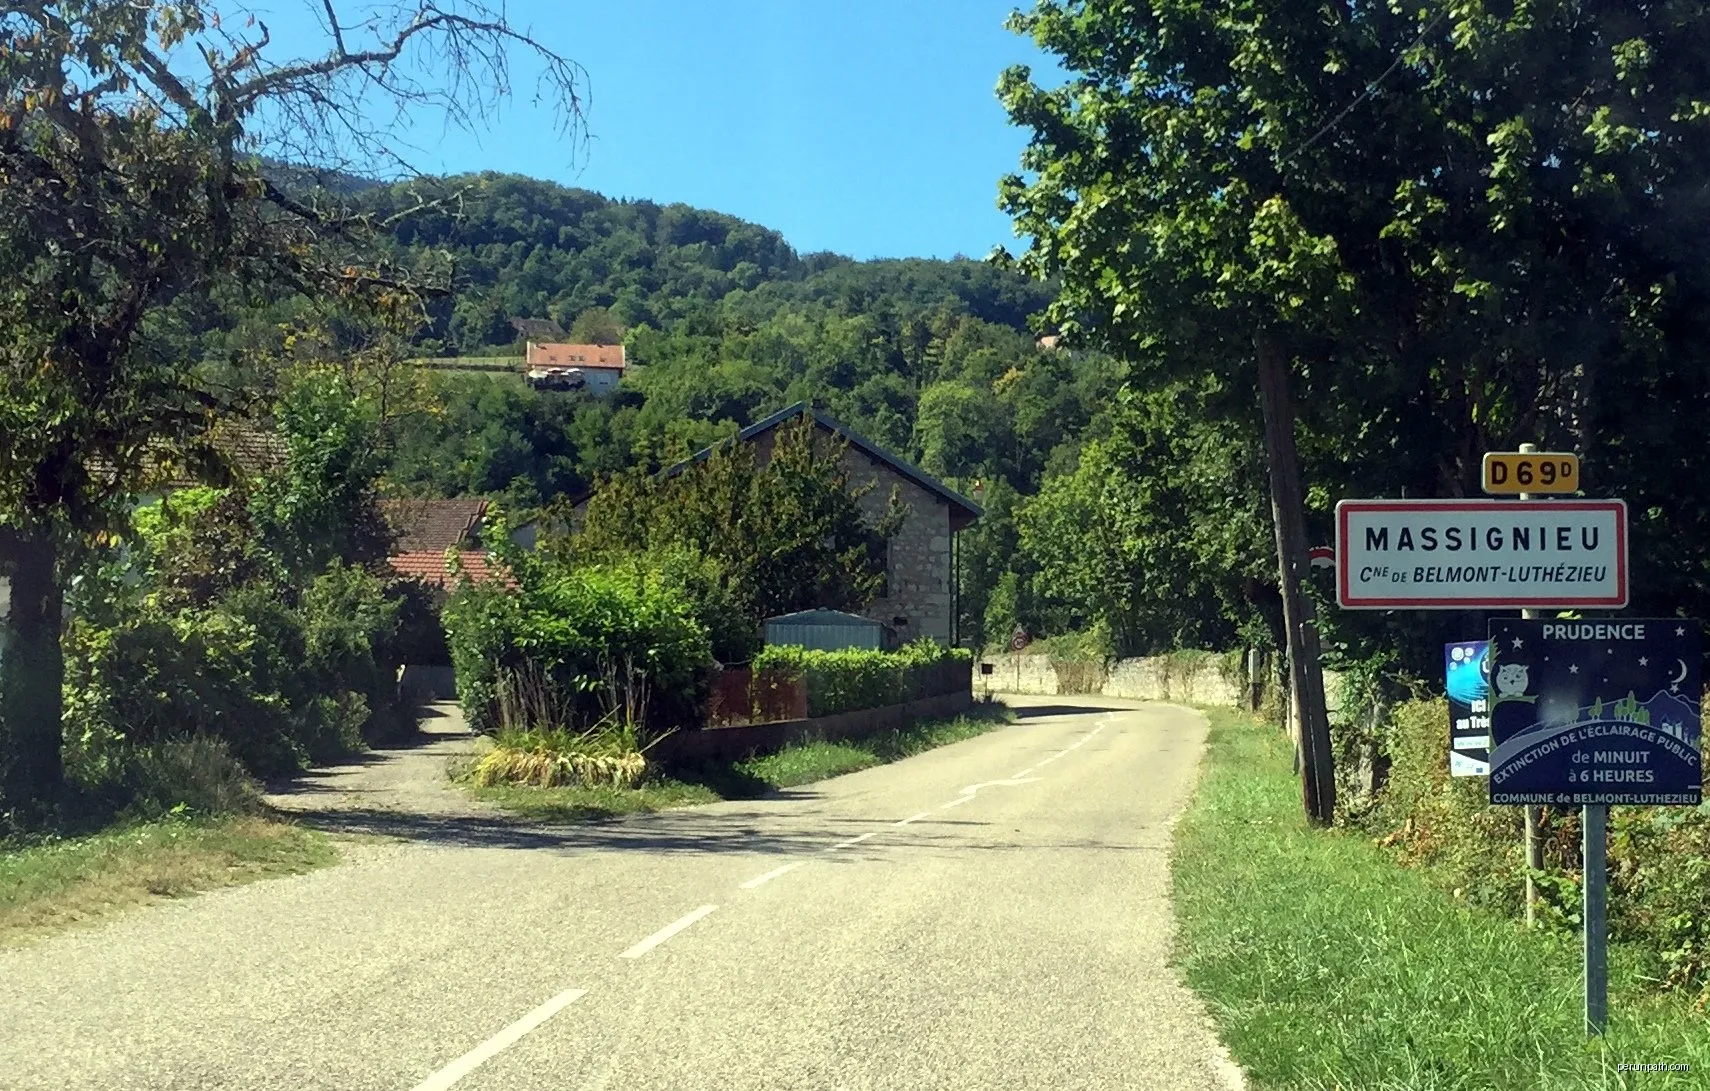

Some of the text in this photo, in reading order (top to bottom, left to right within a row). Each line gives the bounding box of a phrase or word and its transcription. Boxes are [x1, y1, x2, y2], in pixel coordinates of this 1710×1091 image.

[1491, 461, 1508, 485] D
[1365, 527, 1599, 551] MASSIGNIEU
[1391, 571, 1407, 583] DE
[1413, 563, 1606, 583] BELMONT-LUTHÉZIEU
[1543, 624, 1645, 640] PRUDENCE
[1493, 725, 1697, 784] EXTINCTION DE L'ÉCLAIRAGE PUBLIC
[1571, 750, 1650, 764] de MINUIT
[1568, 769, 1654, 782] à 6 HEURES
[1493, 793, 1698, 803] COMMUNE de BELMONT-LUTHEZIEU
